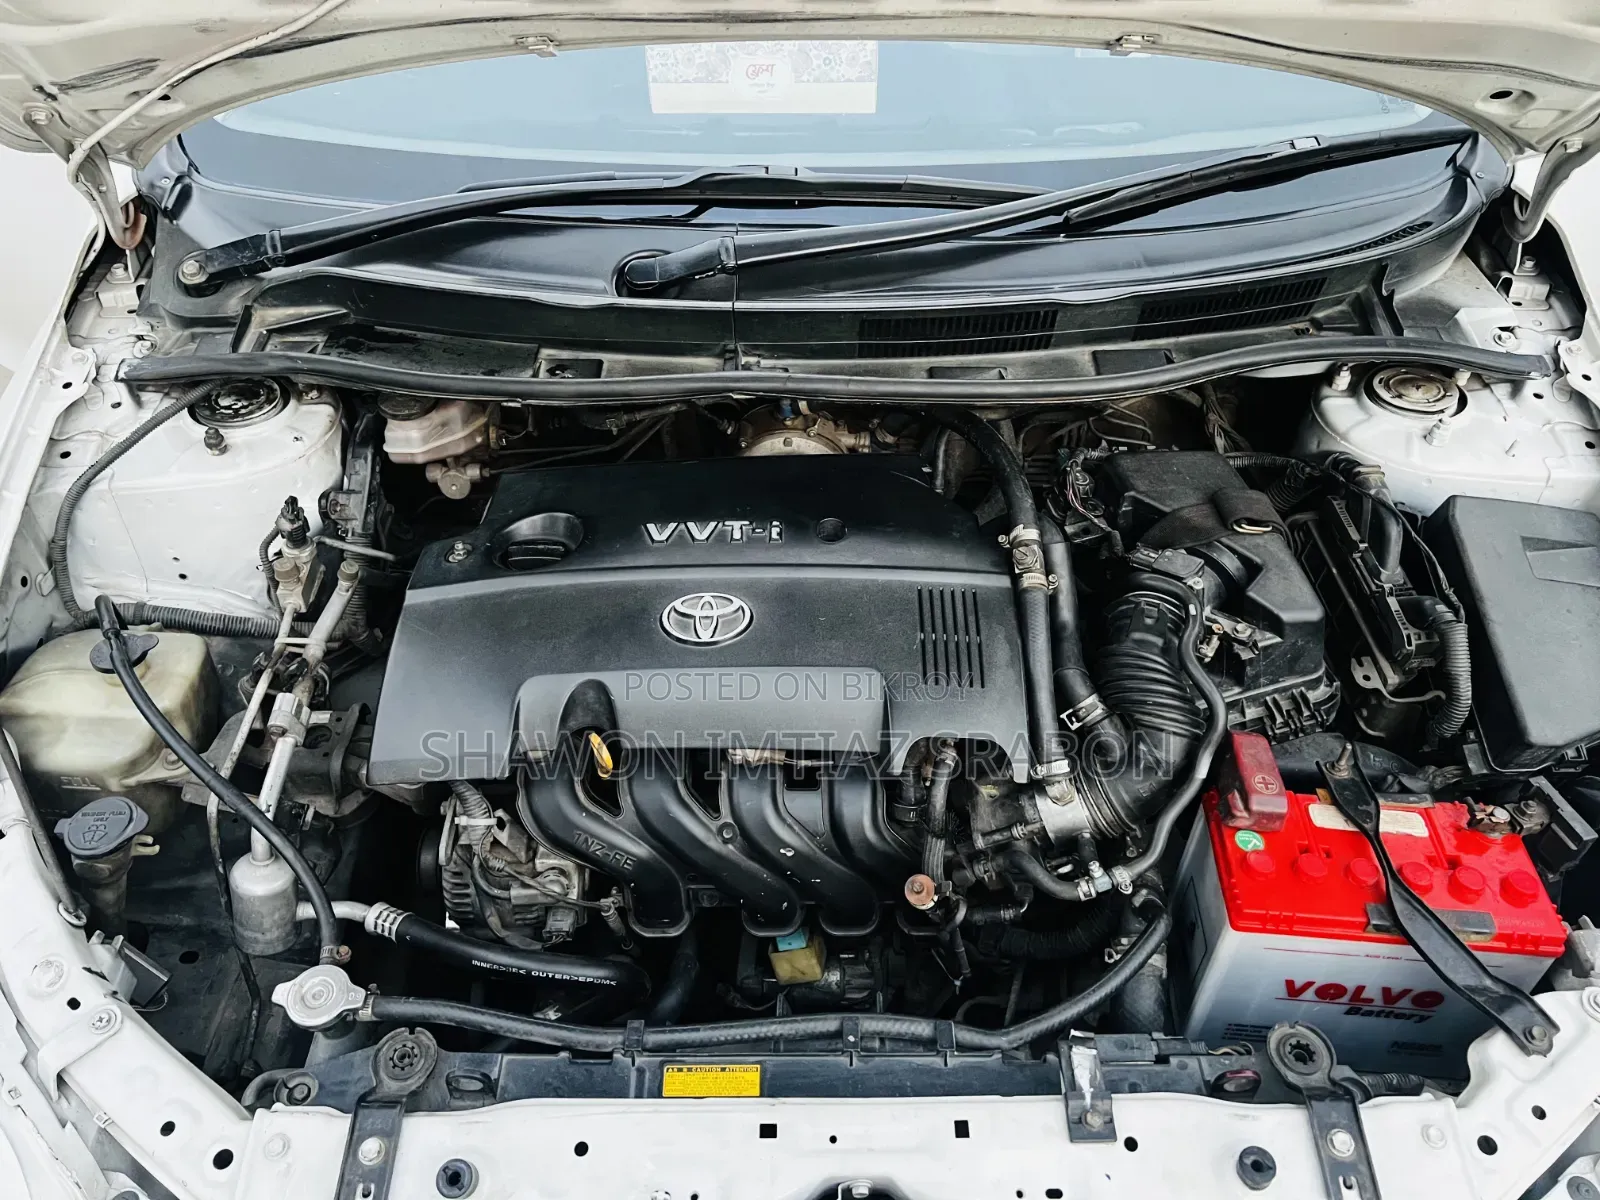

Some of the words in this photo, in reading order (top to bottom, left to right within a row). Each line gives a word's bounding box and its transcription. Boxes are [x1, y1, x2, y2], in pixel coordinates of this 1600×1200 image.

[642, 520, 784, 544] VVT-i
[573, 830, 637, 871] 1NZ-FE
[1284, 979, 1445, 1009] VOLVO
[1343, 1006, 1434, 1023] Battery
